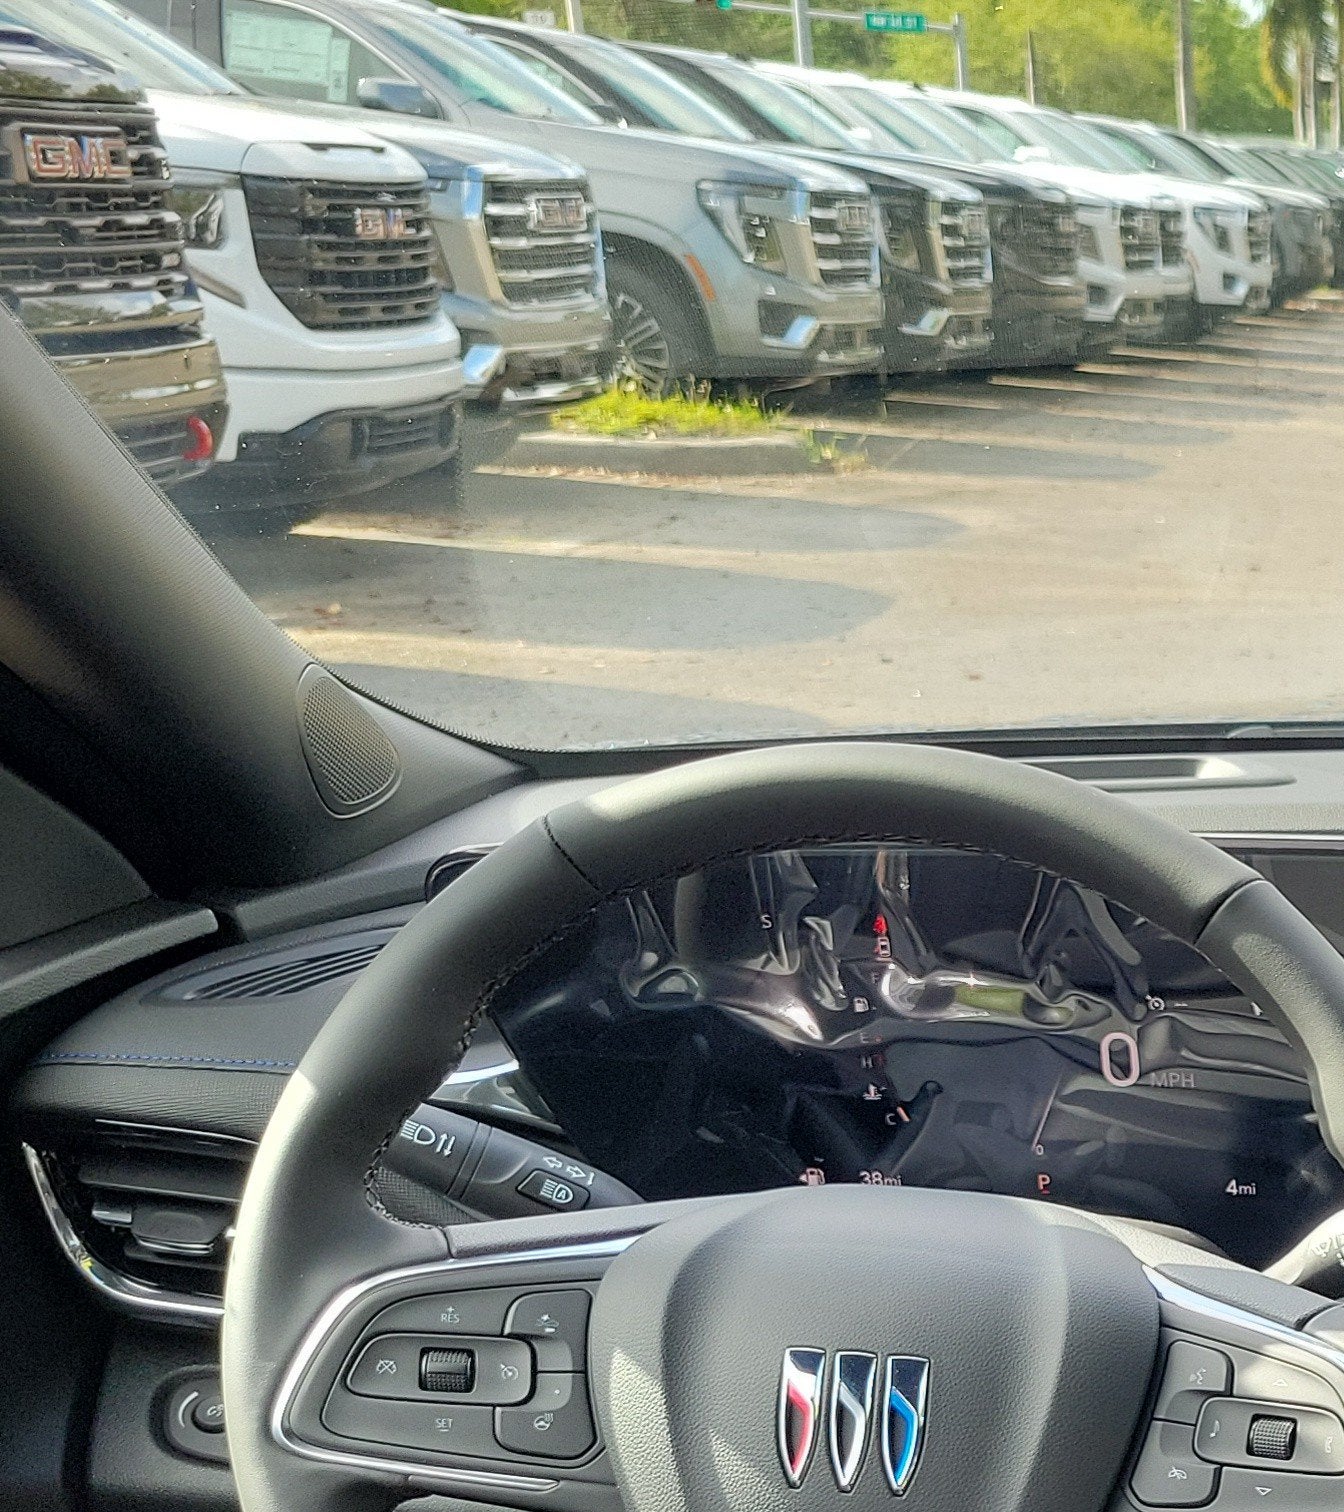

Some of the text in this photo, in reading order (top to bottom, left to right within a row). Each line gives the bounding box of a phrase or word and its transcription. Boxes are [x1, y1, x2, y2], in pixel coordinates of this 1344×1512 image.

[24, 134, 133, 179] GMC
[1100, 1032, 1140, 1087] 0
[1150, 1073, 1196, 1088] MPH
[1037, 1174, 1051, 1190] P
[441, 1313, 460, 1323] RES
[436, 1418, 453, 1428] SET
